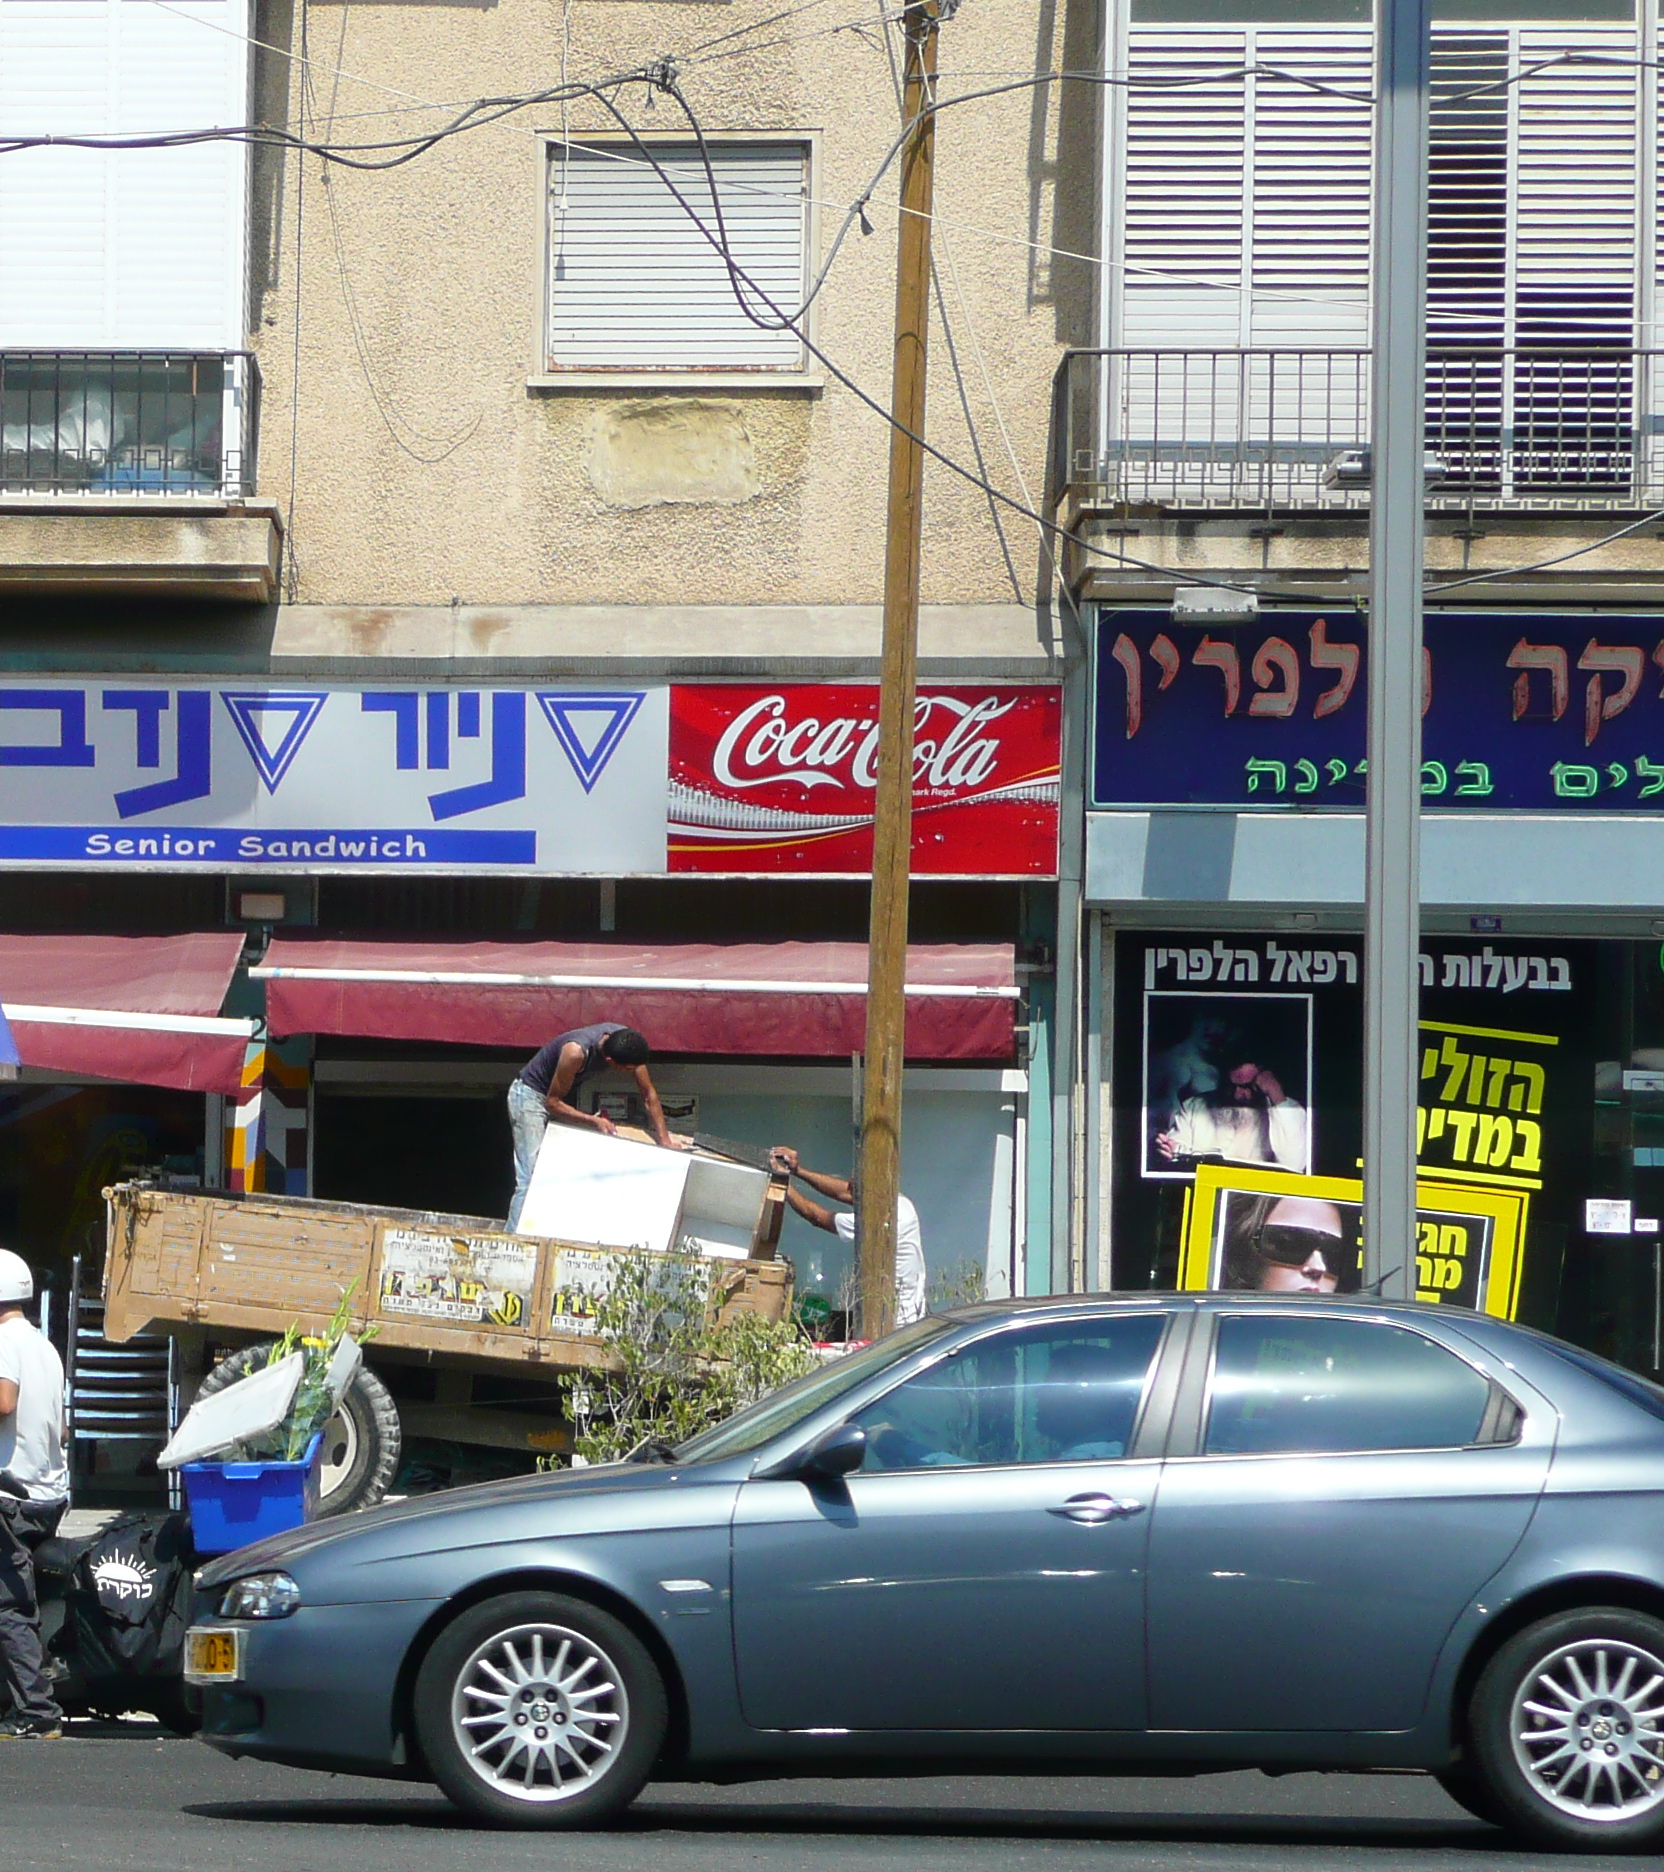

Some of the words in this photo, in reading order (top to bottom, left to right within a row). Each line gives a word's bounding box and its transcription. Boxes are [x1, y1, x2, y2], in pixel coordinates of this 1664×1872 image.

[1113, 619, 1432, 739] לפרין
[1505, 636, 1664, 748] קה
[85, 833, 216, 857] Senior
[237, 833, 428, 859] Sandwich
[1144, 940, 1259, 990] הלפרין
[1267, 941, 1357, 984] רפאל
[1442, 946, 1572, 993] בבעלות
[1420, 1036, 1546, 1115] הזולי
[1417, 1105, 1542, 1173] במדי
